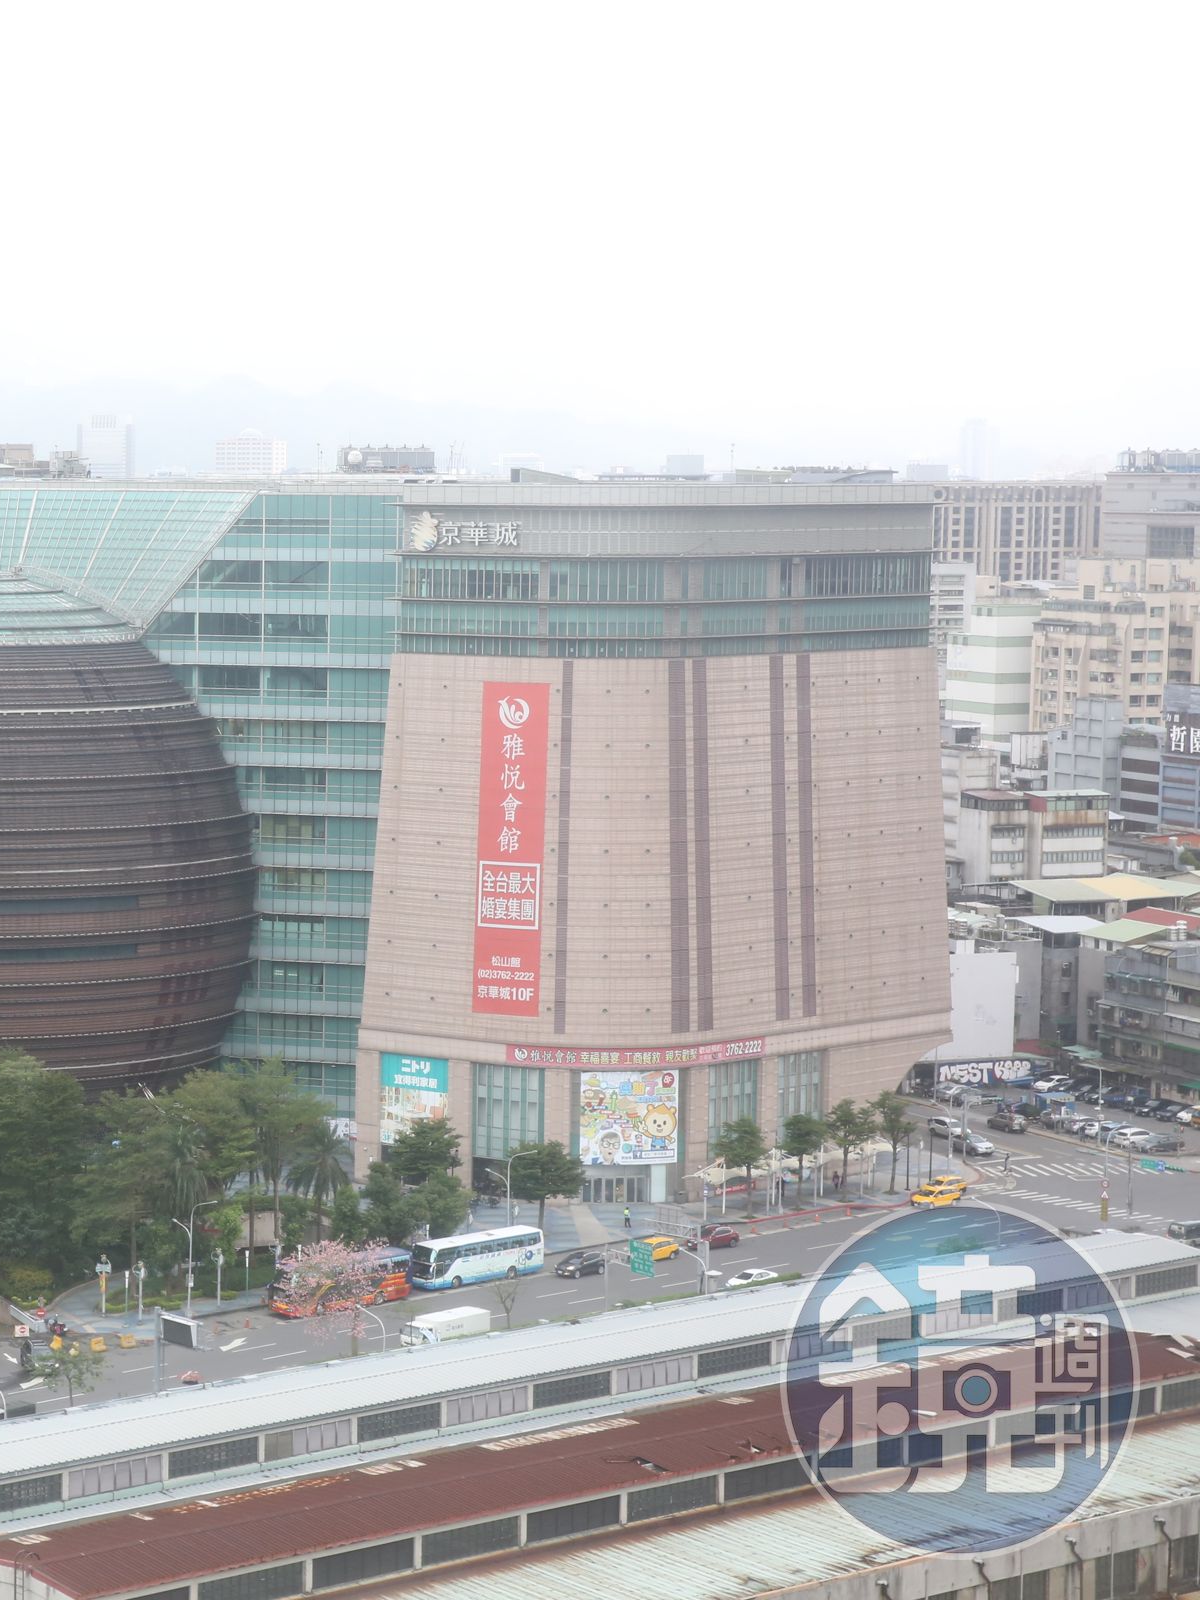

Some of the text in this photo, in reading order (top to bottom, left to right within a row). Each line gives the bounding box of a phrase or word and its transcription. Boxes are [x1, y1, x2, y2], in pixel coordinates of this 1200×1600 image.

[439, 521, 518, 546] 京華城
[482, 870, 535, 895] 全台最大
[481, 895, 535, 921] 婚宴集團
[491, 955, 521, 968] 松山館
[477, 969, 535, 982] (02)3762-2222
[477, 984, 534, 1002] 京華城10F
[725, 1039, 762, 1057] 3762-2222
[401, 1058, 431, 1075] ニトリ
